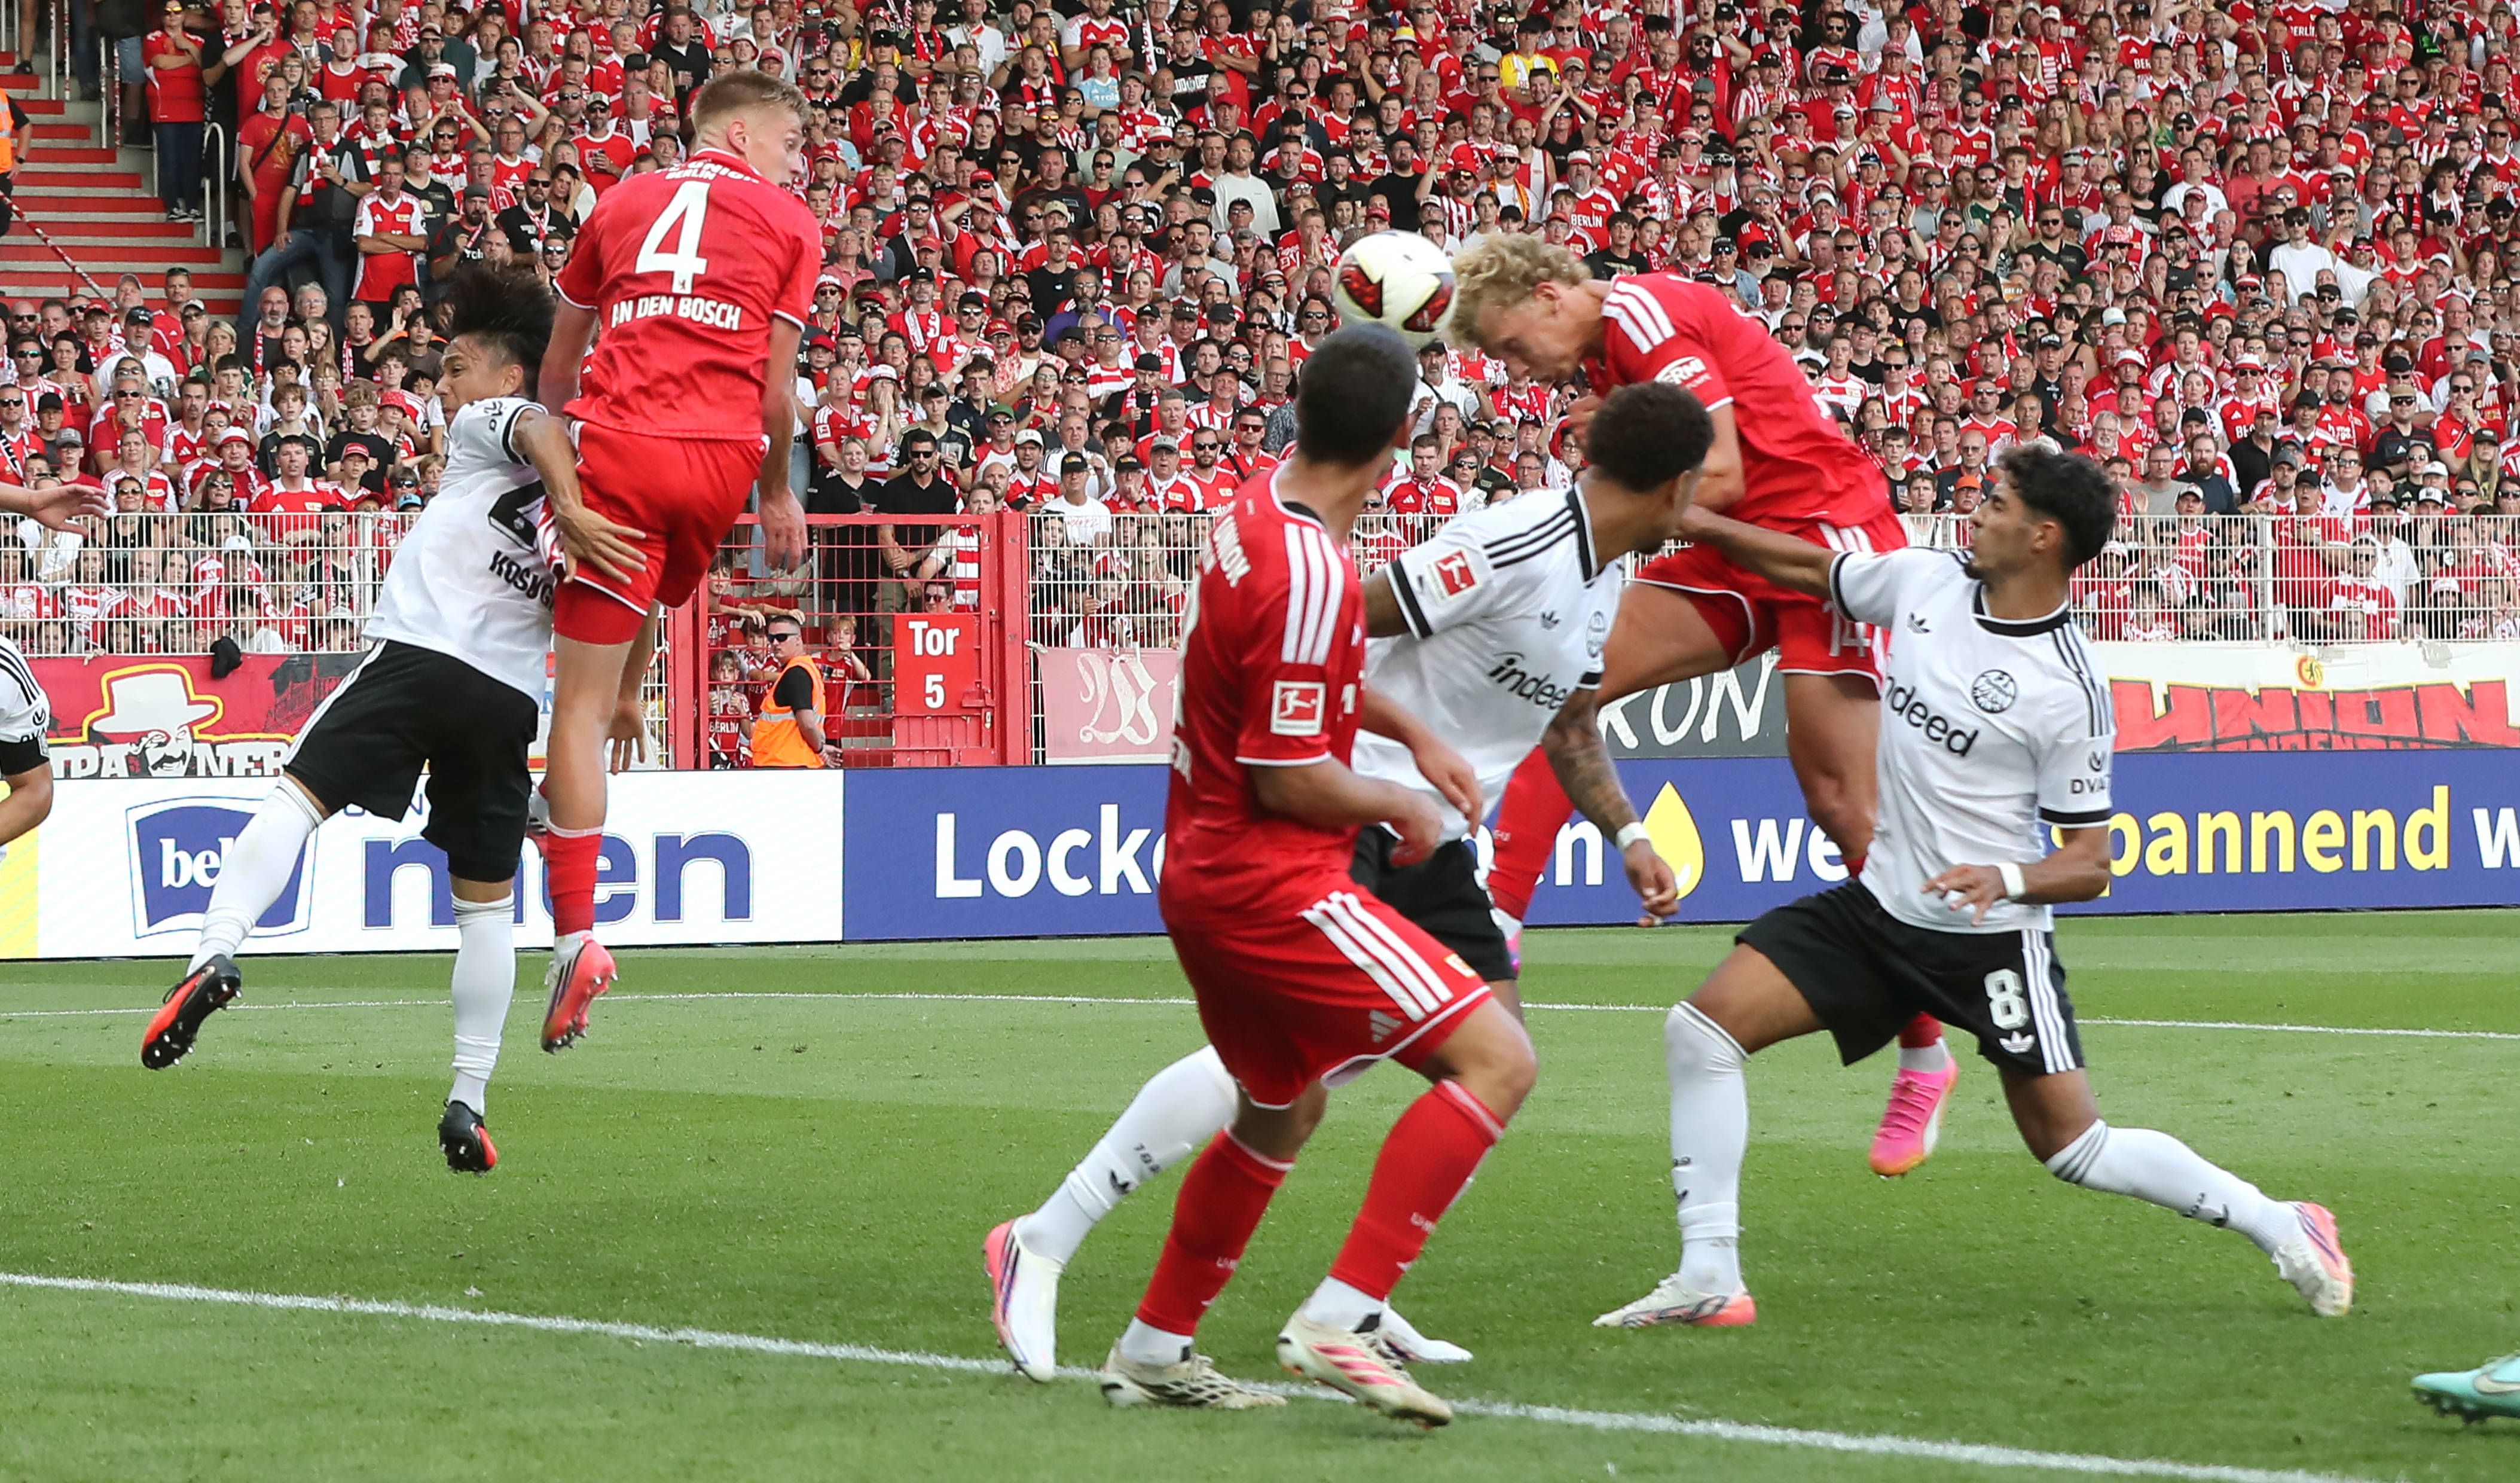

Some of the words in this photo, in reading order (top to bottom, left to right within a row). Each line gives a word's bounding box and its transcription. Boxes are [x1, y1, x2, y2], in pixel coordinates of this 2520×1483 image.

[665, 168, 717, 180] BERLIN
[635, 180, 711, 295] 4
[1571, 211, 1603, 228] BERLIN
[636, 295, 674, 319] DEN
[677, 296, 742, 331] BOSCH
[908, 620, 961, 657] Tor
[924, 673, 946, 709] 5
[1487, 653, 1568, 710] indee
[1886, 676, 1979, 758] ndeed
[2110, 679, 2520, 750] UNION
[1730, 817, 1850, 883] we
[2101, 785, 2451, 898] pannend
[1984, 968, 2029, 1030] 8
